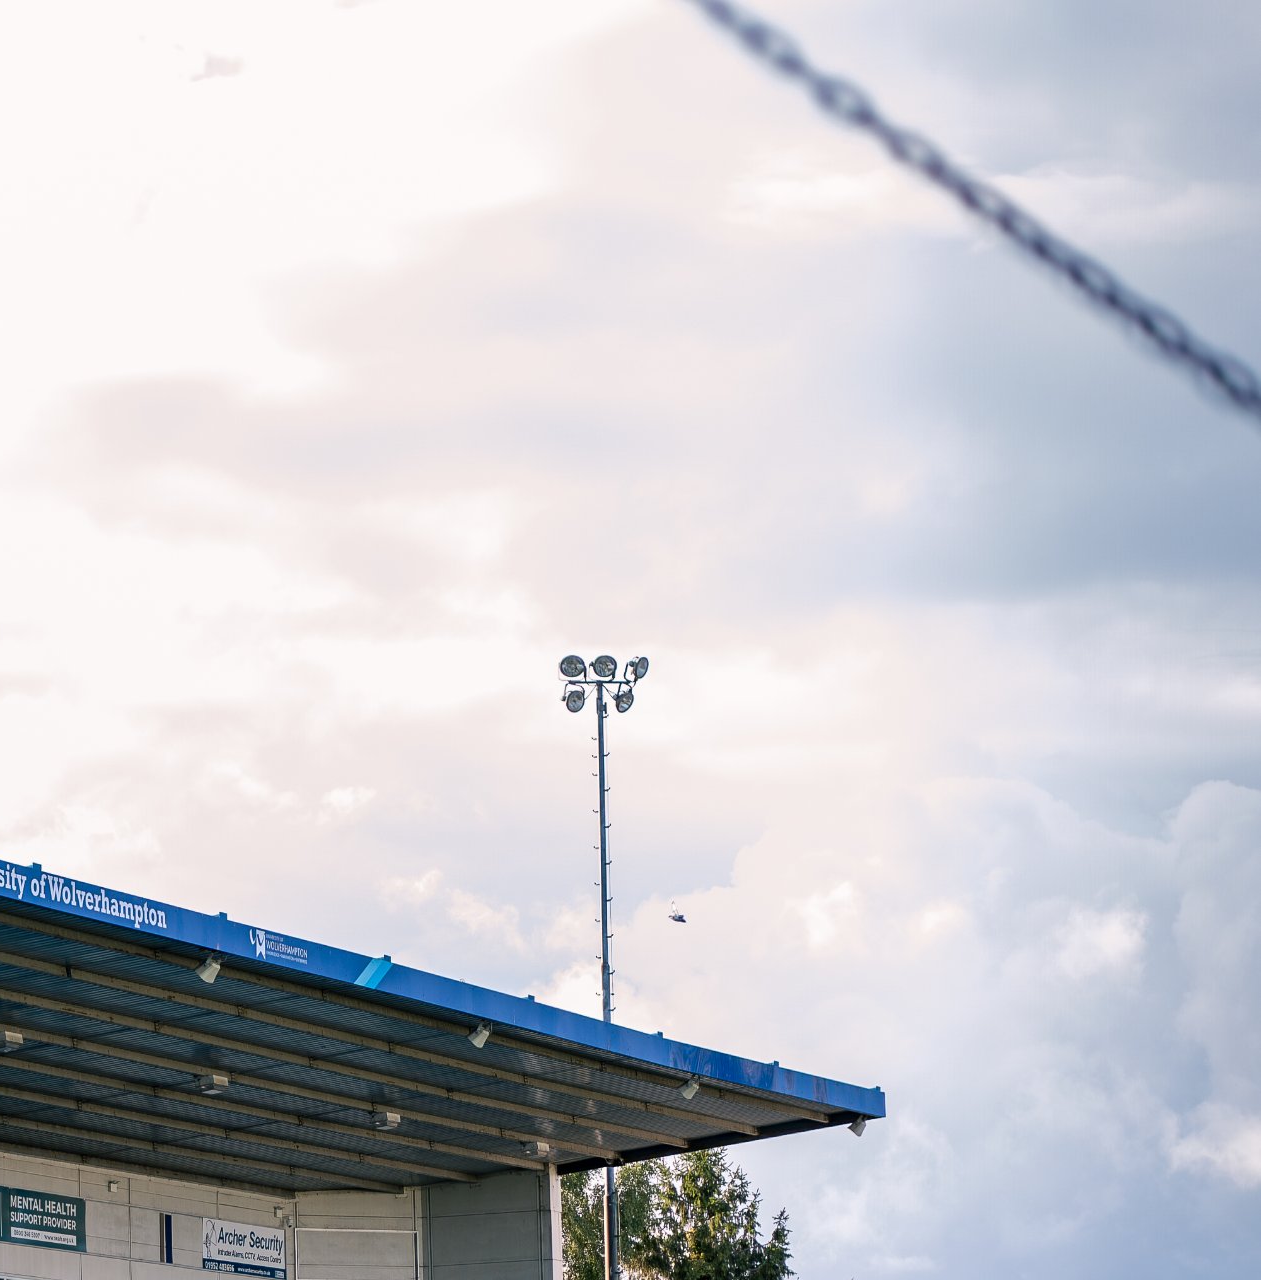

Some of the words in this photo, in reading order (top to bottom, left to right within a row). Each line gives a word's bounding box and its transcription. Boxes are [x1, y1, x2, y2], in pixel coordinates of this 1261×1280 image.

[30, 874, 46, 899] of
[48, 874, 167, 929] Wolverhampton
[10, 1194, 43, 1212] MENTAL
[44, 1199, 77, 1217] HEALTH
[10, 1211, 41, 1226] SUPPORT
[42, 1216, 77, 1231] PROVIDER
[218, 1226, 247, 1247] Archer
[249, 1231, 284, 1256] Security
